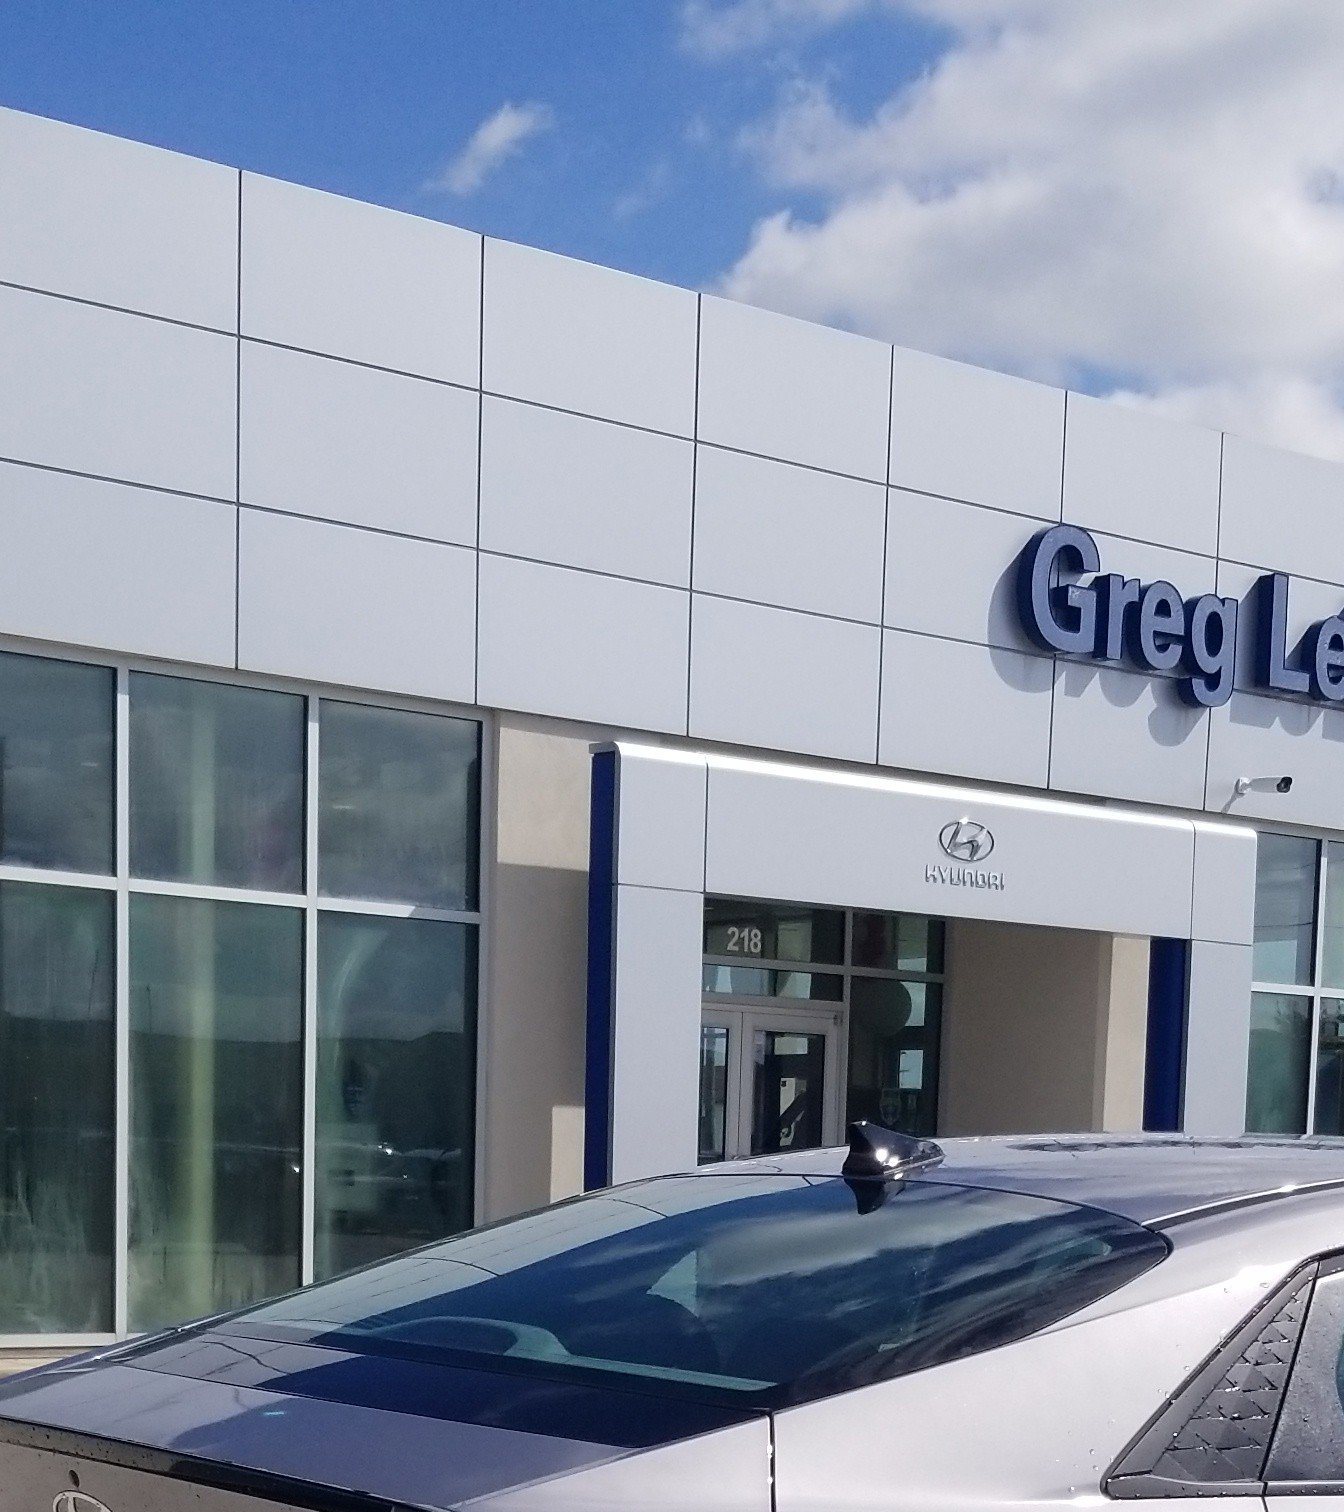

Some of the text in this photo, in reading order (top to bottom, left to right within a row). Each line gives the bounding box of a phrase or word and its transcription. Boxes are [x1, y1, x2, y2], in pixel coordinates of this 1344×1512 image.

[1024, 521, 1239, 709] Greg
[924, 864, 1005, 891] HYUNDAI
[726, 926, 762, 953] 218
